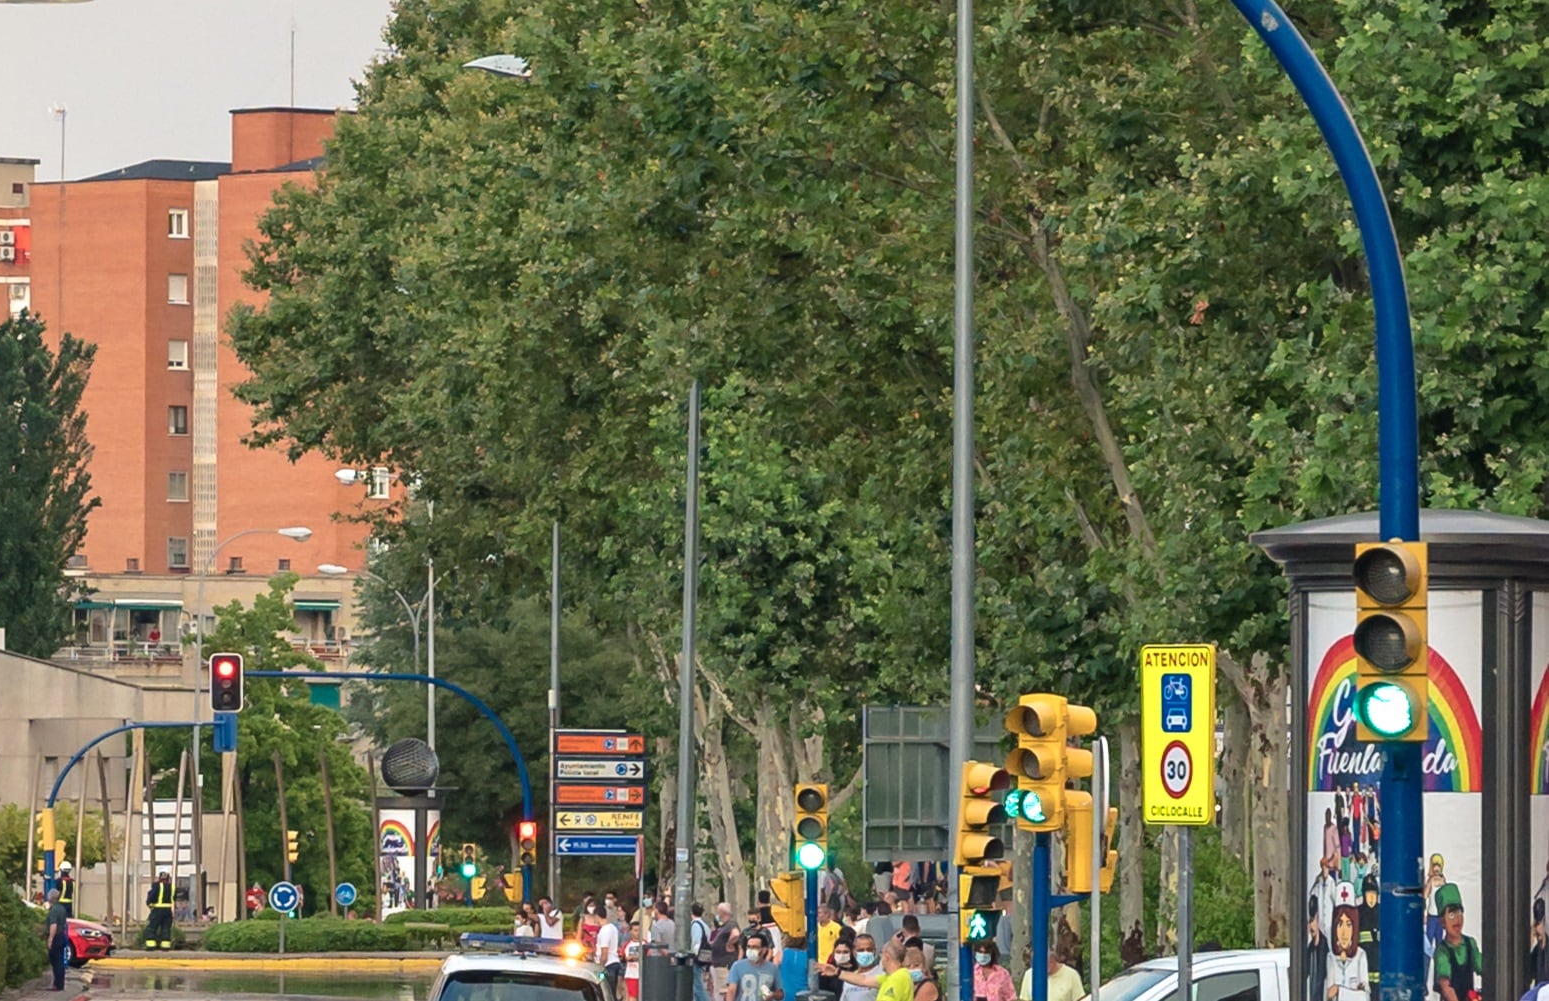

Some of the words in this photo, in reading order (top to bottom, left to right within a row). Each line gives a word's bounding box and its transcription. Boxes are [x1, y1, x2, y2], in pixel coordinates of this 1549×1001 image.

[1144, 652, 1209, 667] ATENCION
[1317, 732, 1460, 781] Fuenlada
[1166, 760, 1187, 780] 30
[1151, 805, 1203, 817] CICLOCALLE
